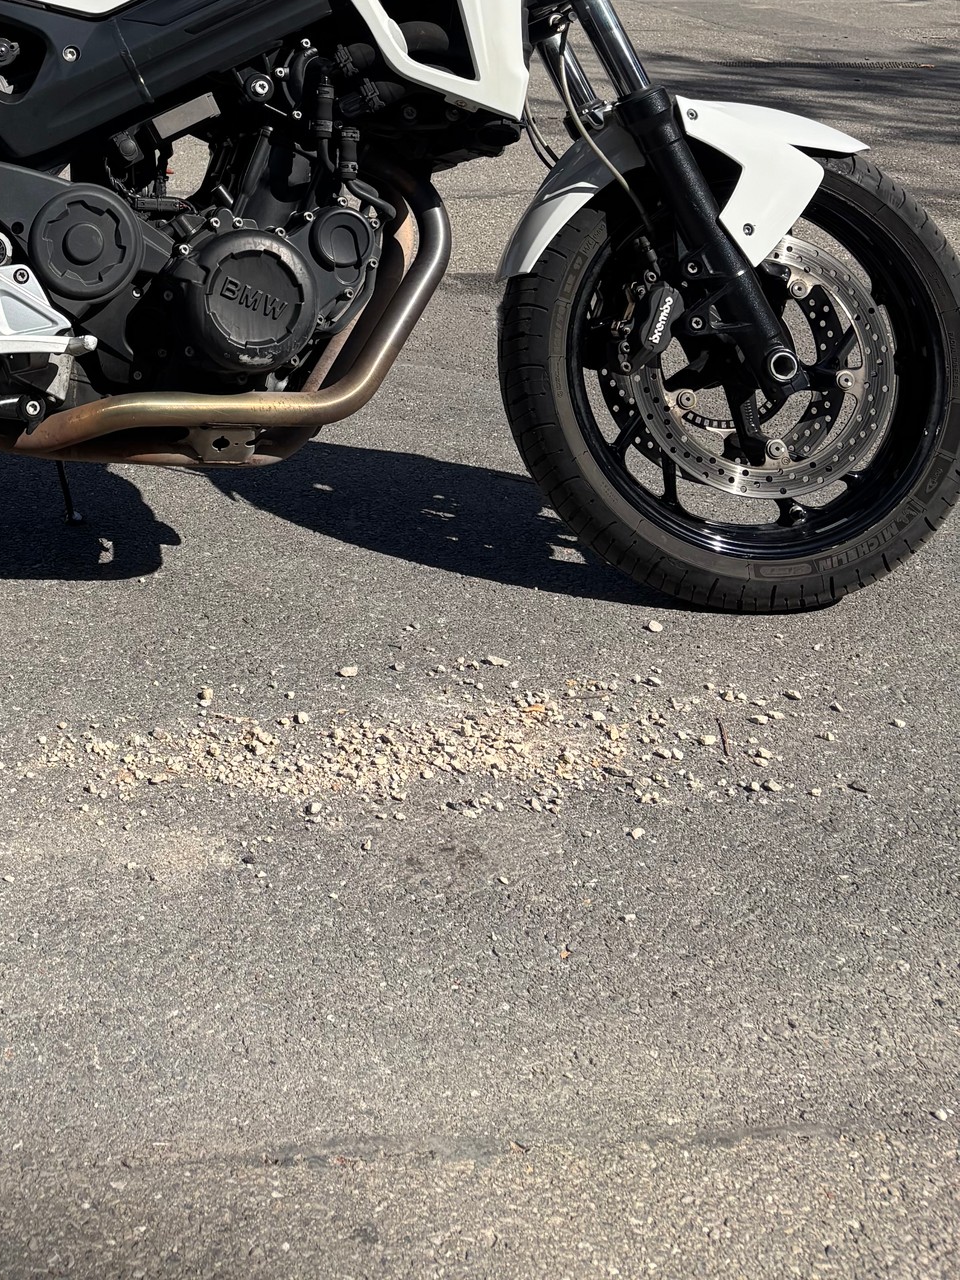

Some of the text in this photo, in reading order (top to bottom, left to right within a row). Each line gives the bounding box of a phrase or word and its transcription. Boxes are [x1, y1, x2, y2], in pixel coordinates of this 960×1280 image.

[220, 276, 289, 320] BMW
[649, 296, 673, 344] brembo
[816, 523, 902, 571] MICHELIN
